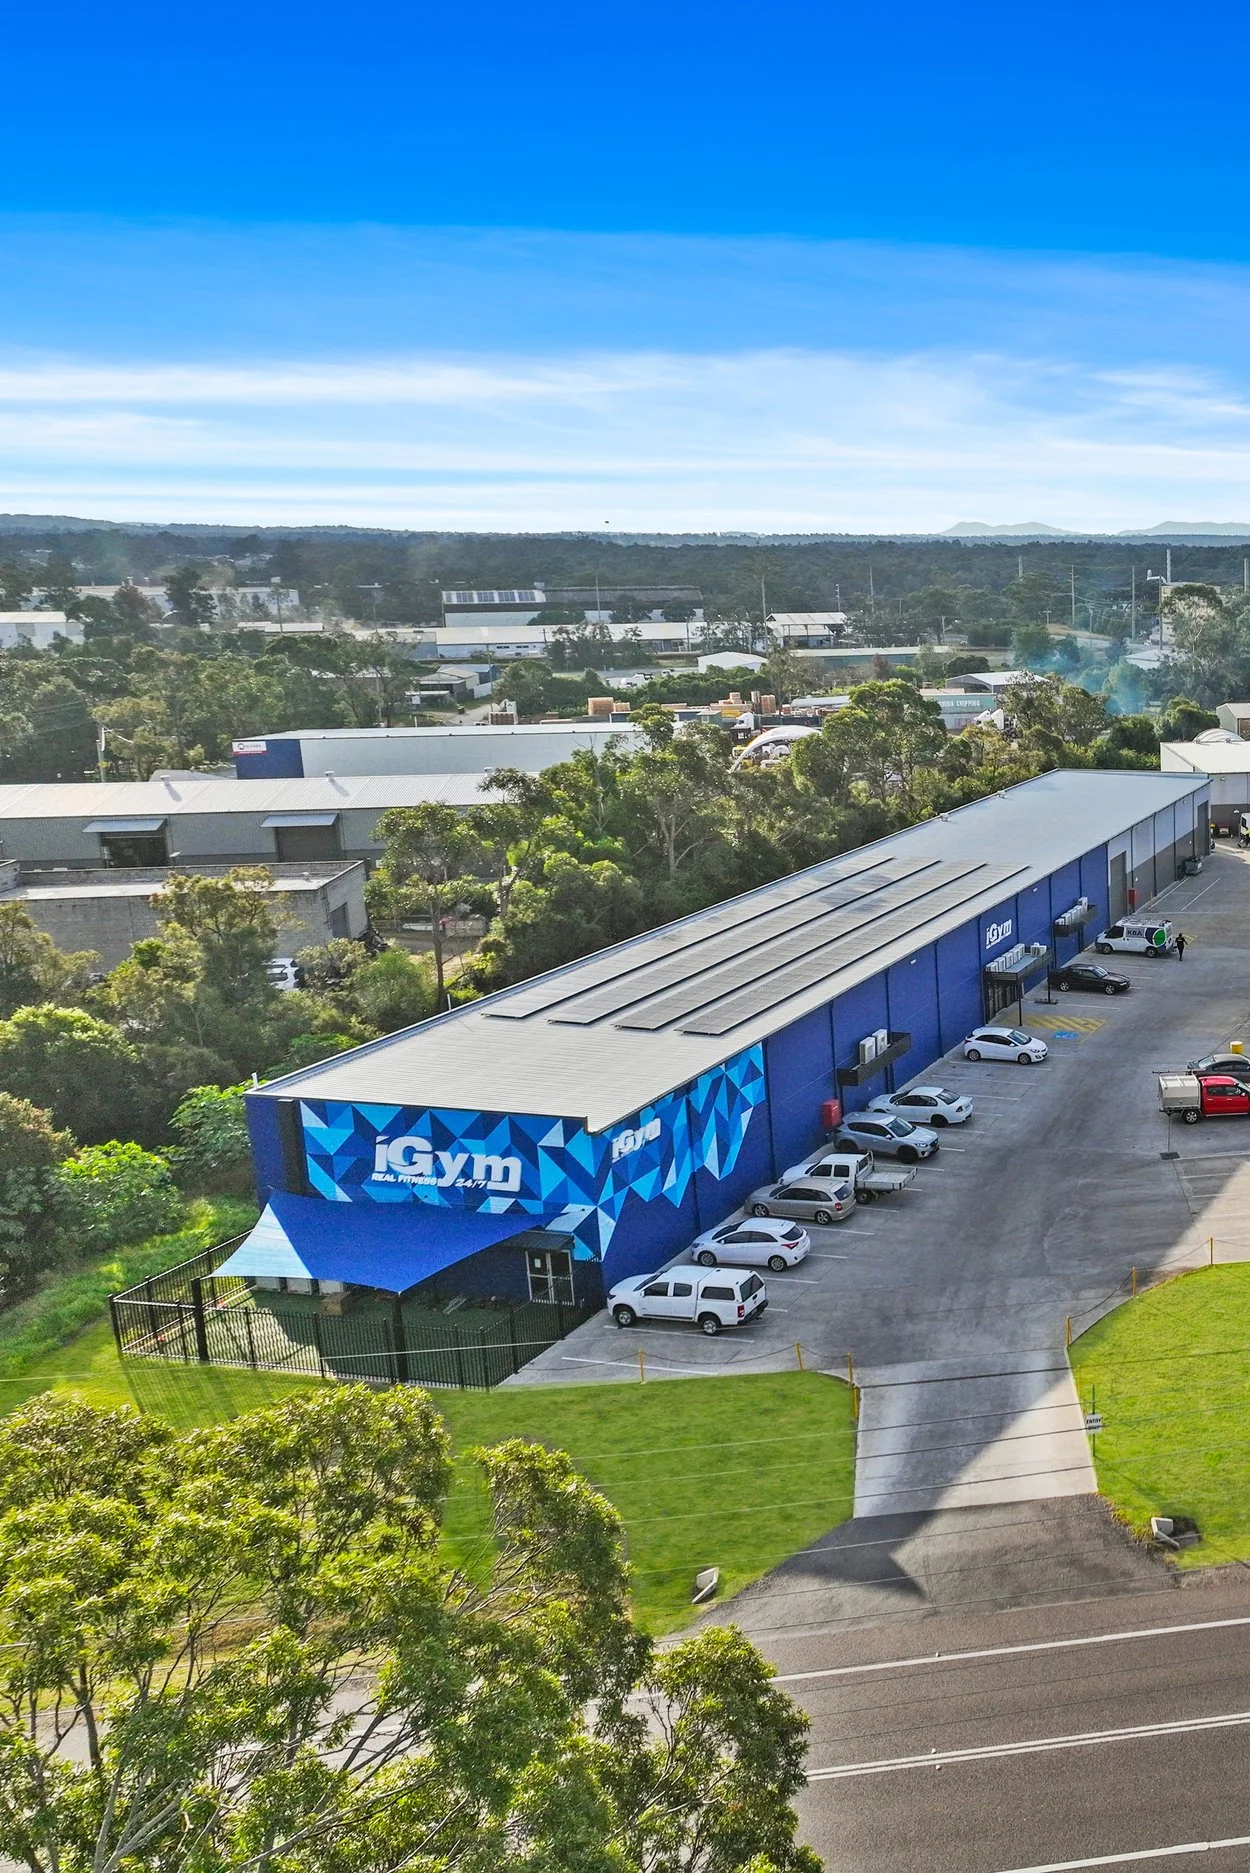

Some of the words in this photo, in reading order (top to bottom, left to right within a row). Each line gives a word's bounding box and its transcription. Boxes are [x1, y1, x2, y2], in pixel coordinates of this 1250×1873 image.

[986, 918, 1011, 945] iGym
[612, 1118, 661, 1158] iGym
[375, 1135, 522, 1192] iGym
[371, 1173, 396, 1182] REAL
[398, 1174, 438, 1186] FITNESS
[455, 1178, 488, 1188] 24/7
